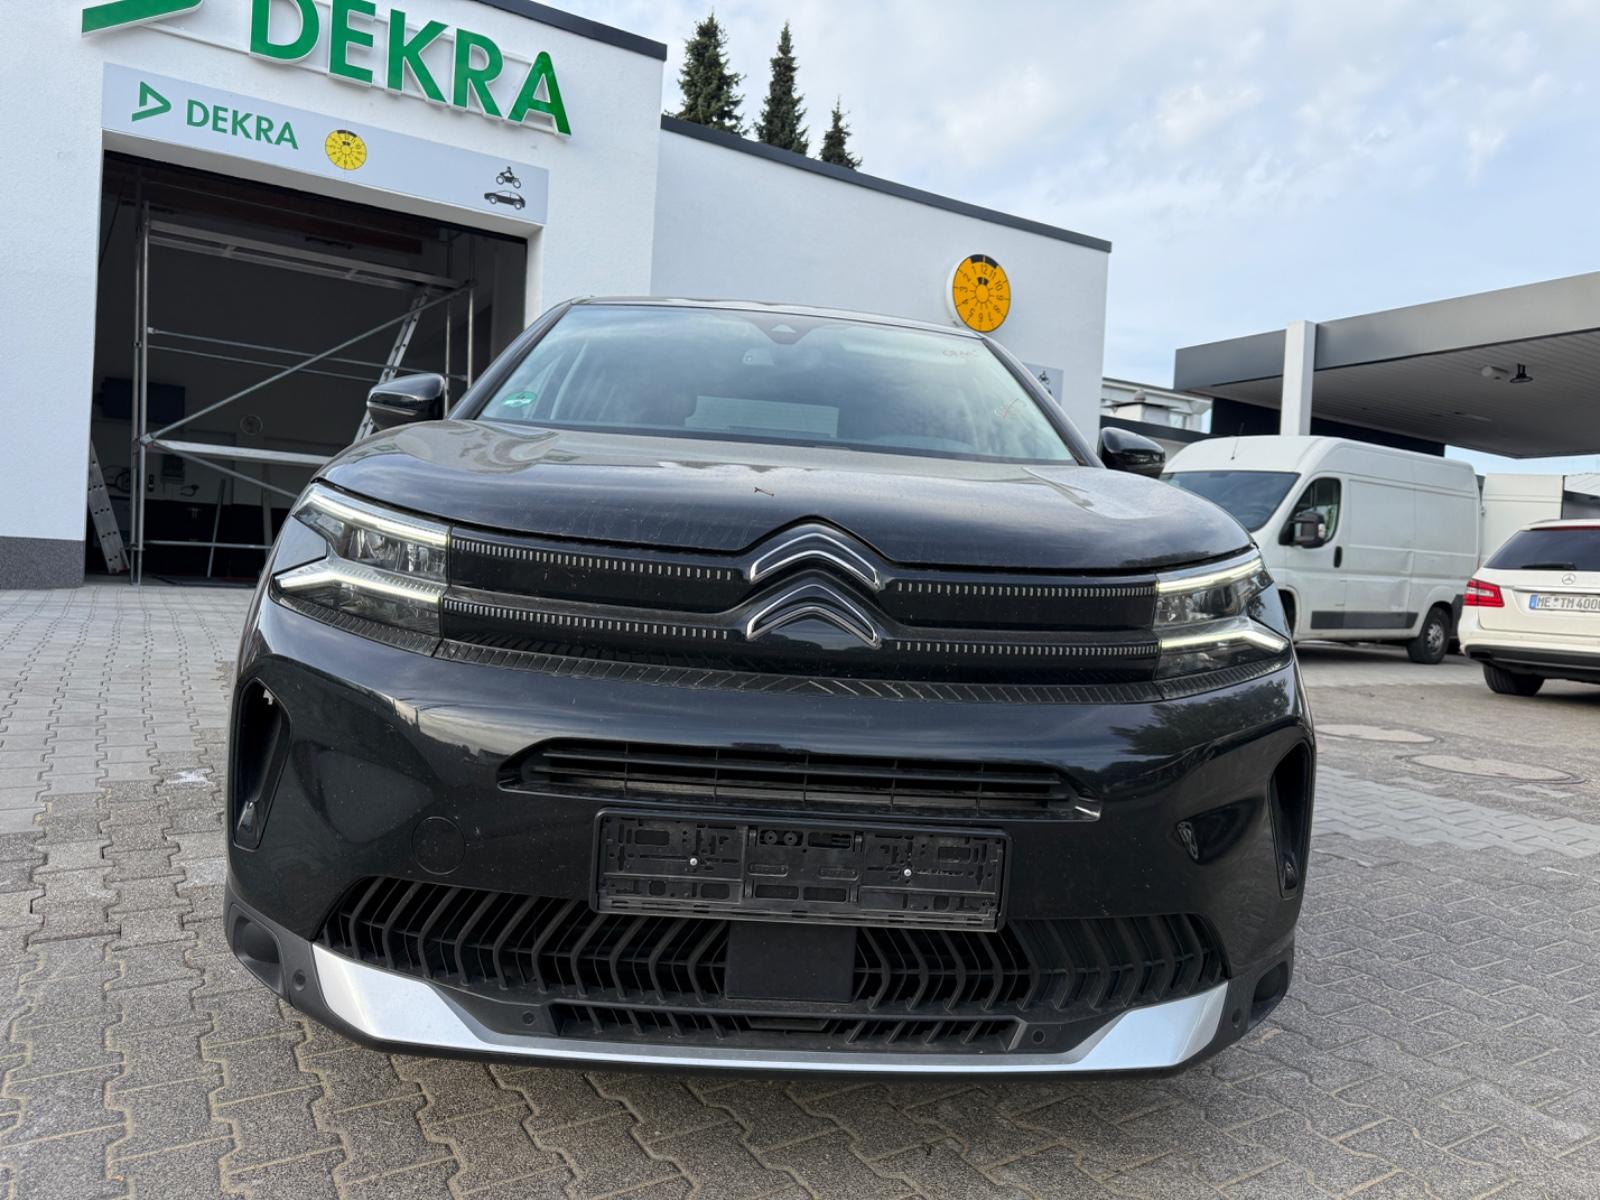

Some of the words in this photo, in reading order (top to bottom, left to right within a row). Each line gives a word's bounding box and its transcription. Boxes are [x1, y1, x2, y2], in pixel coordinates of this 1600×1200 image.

[249, 0, 572, 136] DEKRA
[186, 99, 299, 150] DEKRA
[1537, 597, 1552, 608] ME
